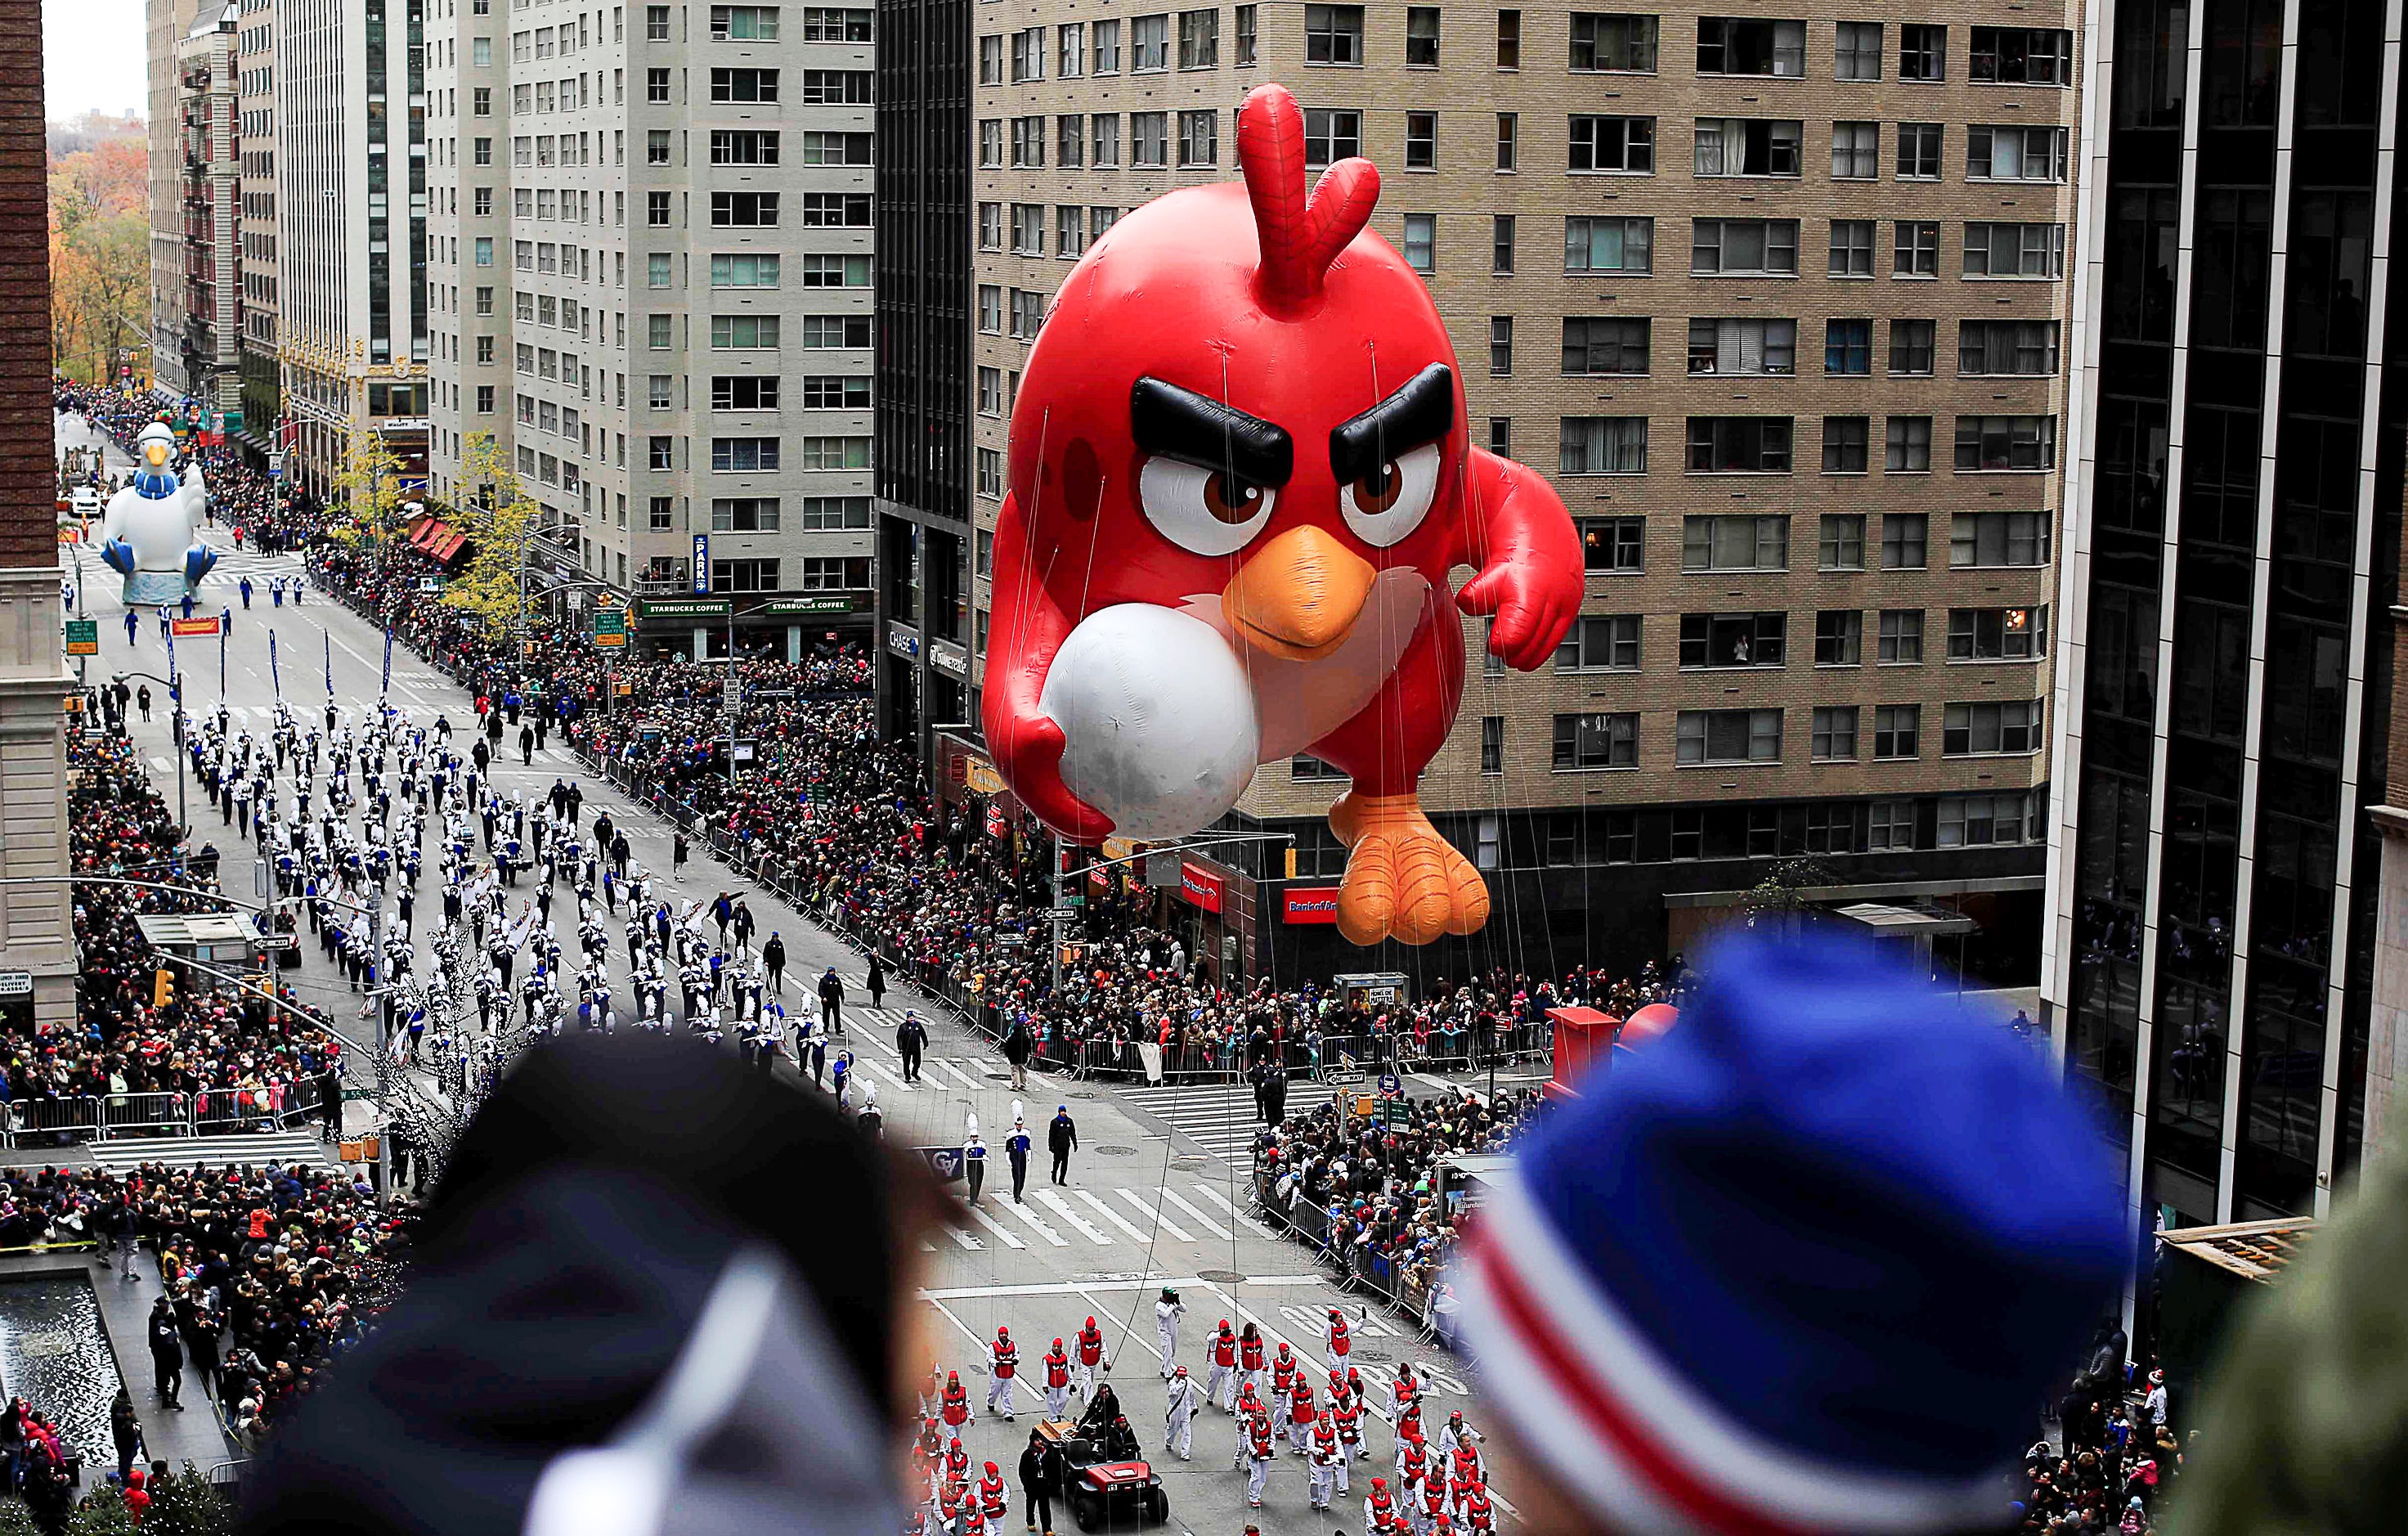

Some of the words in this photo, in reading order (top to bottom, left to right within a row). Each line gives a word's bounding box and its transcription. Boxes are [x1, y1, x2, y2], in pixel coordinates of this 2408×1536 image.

[696, 544, 705, 579] PARK
[890, 631, 912, 653] CHASE
[1289, 901, 1314, 912] Bank
[1313, 900, 1325, 910] of
[858, 1008, 936, 1027] BUS
[340, 1091, 347, 1099] W
